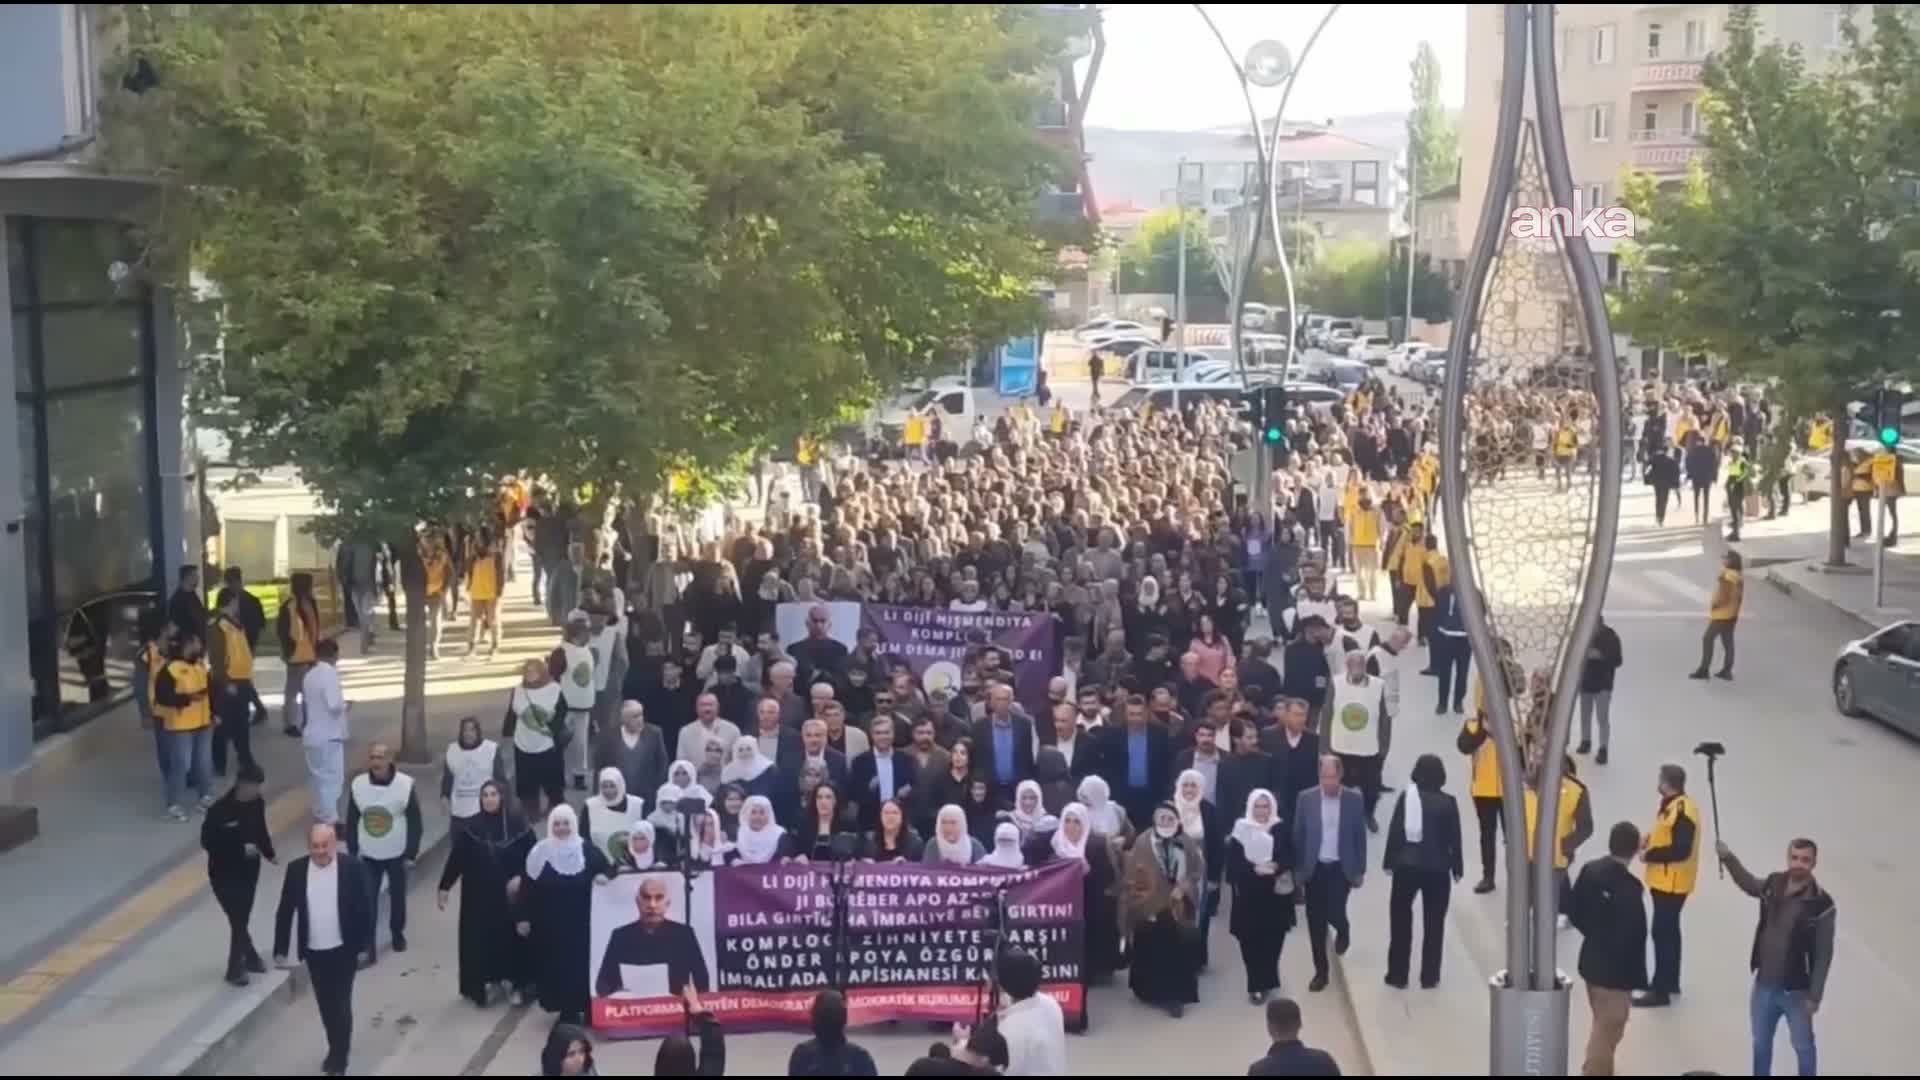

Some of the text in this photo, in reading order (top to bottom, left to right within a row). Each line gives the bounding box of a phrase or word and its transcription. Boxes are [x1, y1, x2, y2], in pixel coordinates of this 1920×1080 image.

[883, 610, 897, 622] LI
[762, 874, 779, 889] LI
[795, 895, 808, 911] JI
[904, 893, 942, 907] APO
[728, 911, 768, 928] BILA
[1007, 903, 1073, 920] GIRTIN!
[1006, 928, 1067, 945] ARŞI!
[746, 952, 822, 970] ÖNDER
[790, 970, 829, 987] ADA
